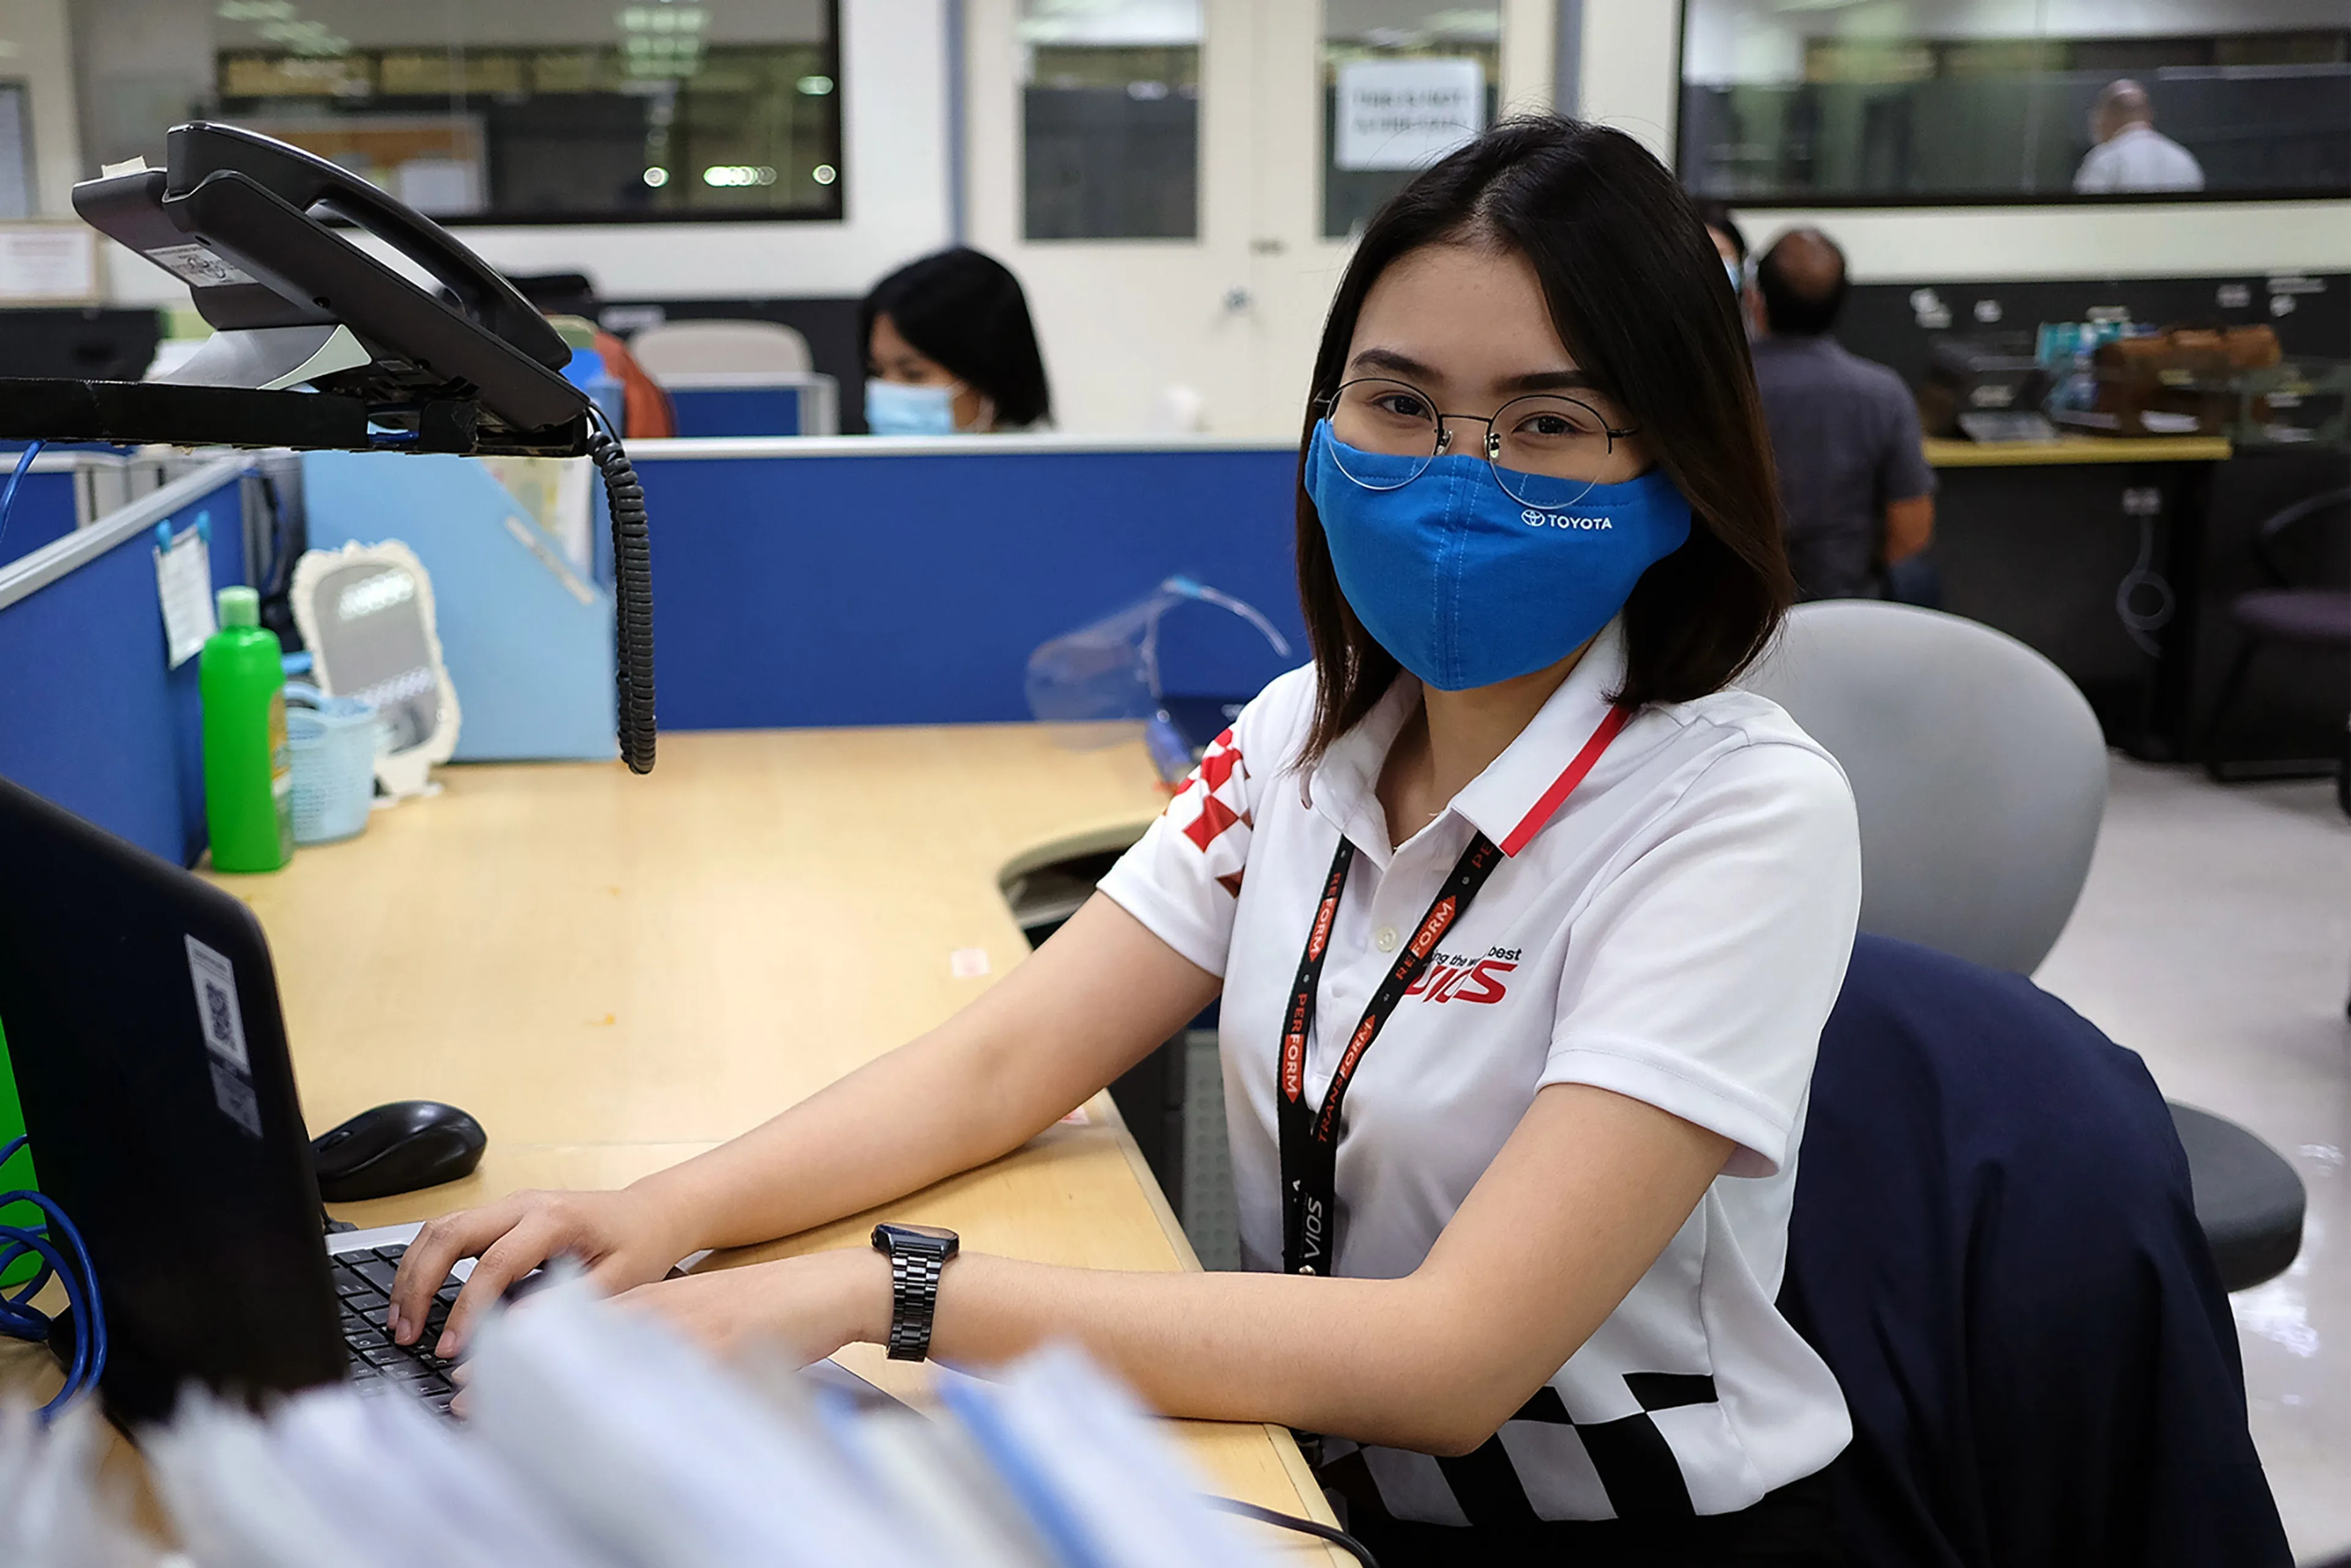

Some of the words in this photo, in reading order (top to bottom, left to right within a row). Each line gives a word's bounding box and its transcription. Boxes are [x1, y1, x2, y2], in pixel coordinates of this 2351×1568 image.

[1547, 514, 1613, 530] TOYOTA
[1311, 872, 1341, 953] REFORM
[1488, 945, 1523, 961] best
[1318, 1021, 1373, 1142] TRANSFORM
[1395, 901, 1453, 981] REFORM
[1471, 841, 1494, 869] PE
[1286, 992, 1308, 1093] PERFORM
[1303, 1196, 1322, 1258] VIOS
